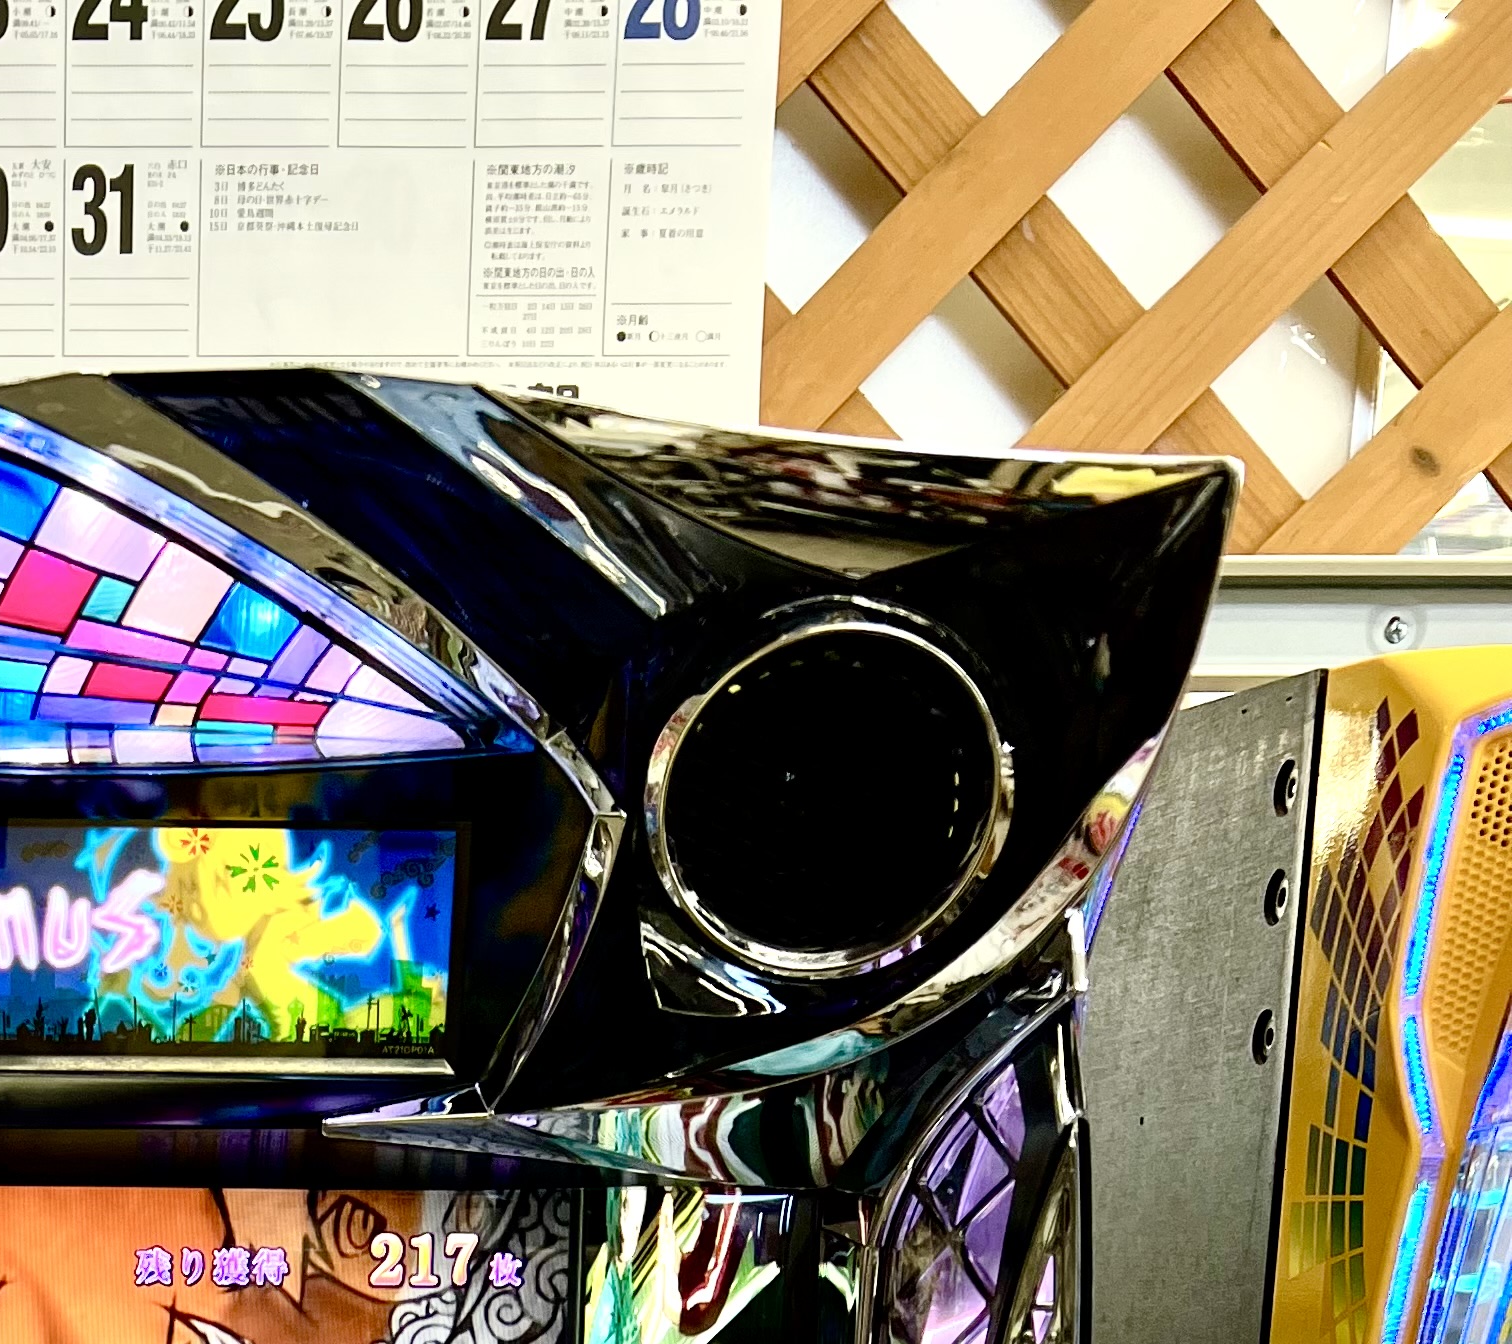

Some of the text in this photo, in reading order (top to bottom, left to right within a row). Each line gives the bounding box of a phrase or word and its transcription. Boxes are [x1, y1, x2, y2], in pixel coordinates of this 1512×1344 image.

[71, 163, 134, 256] 31
[134, 1245, 289, 1285] 残り獲得
